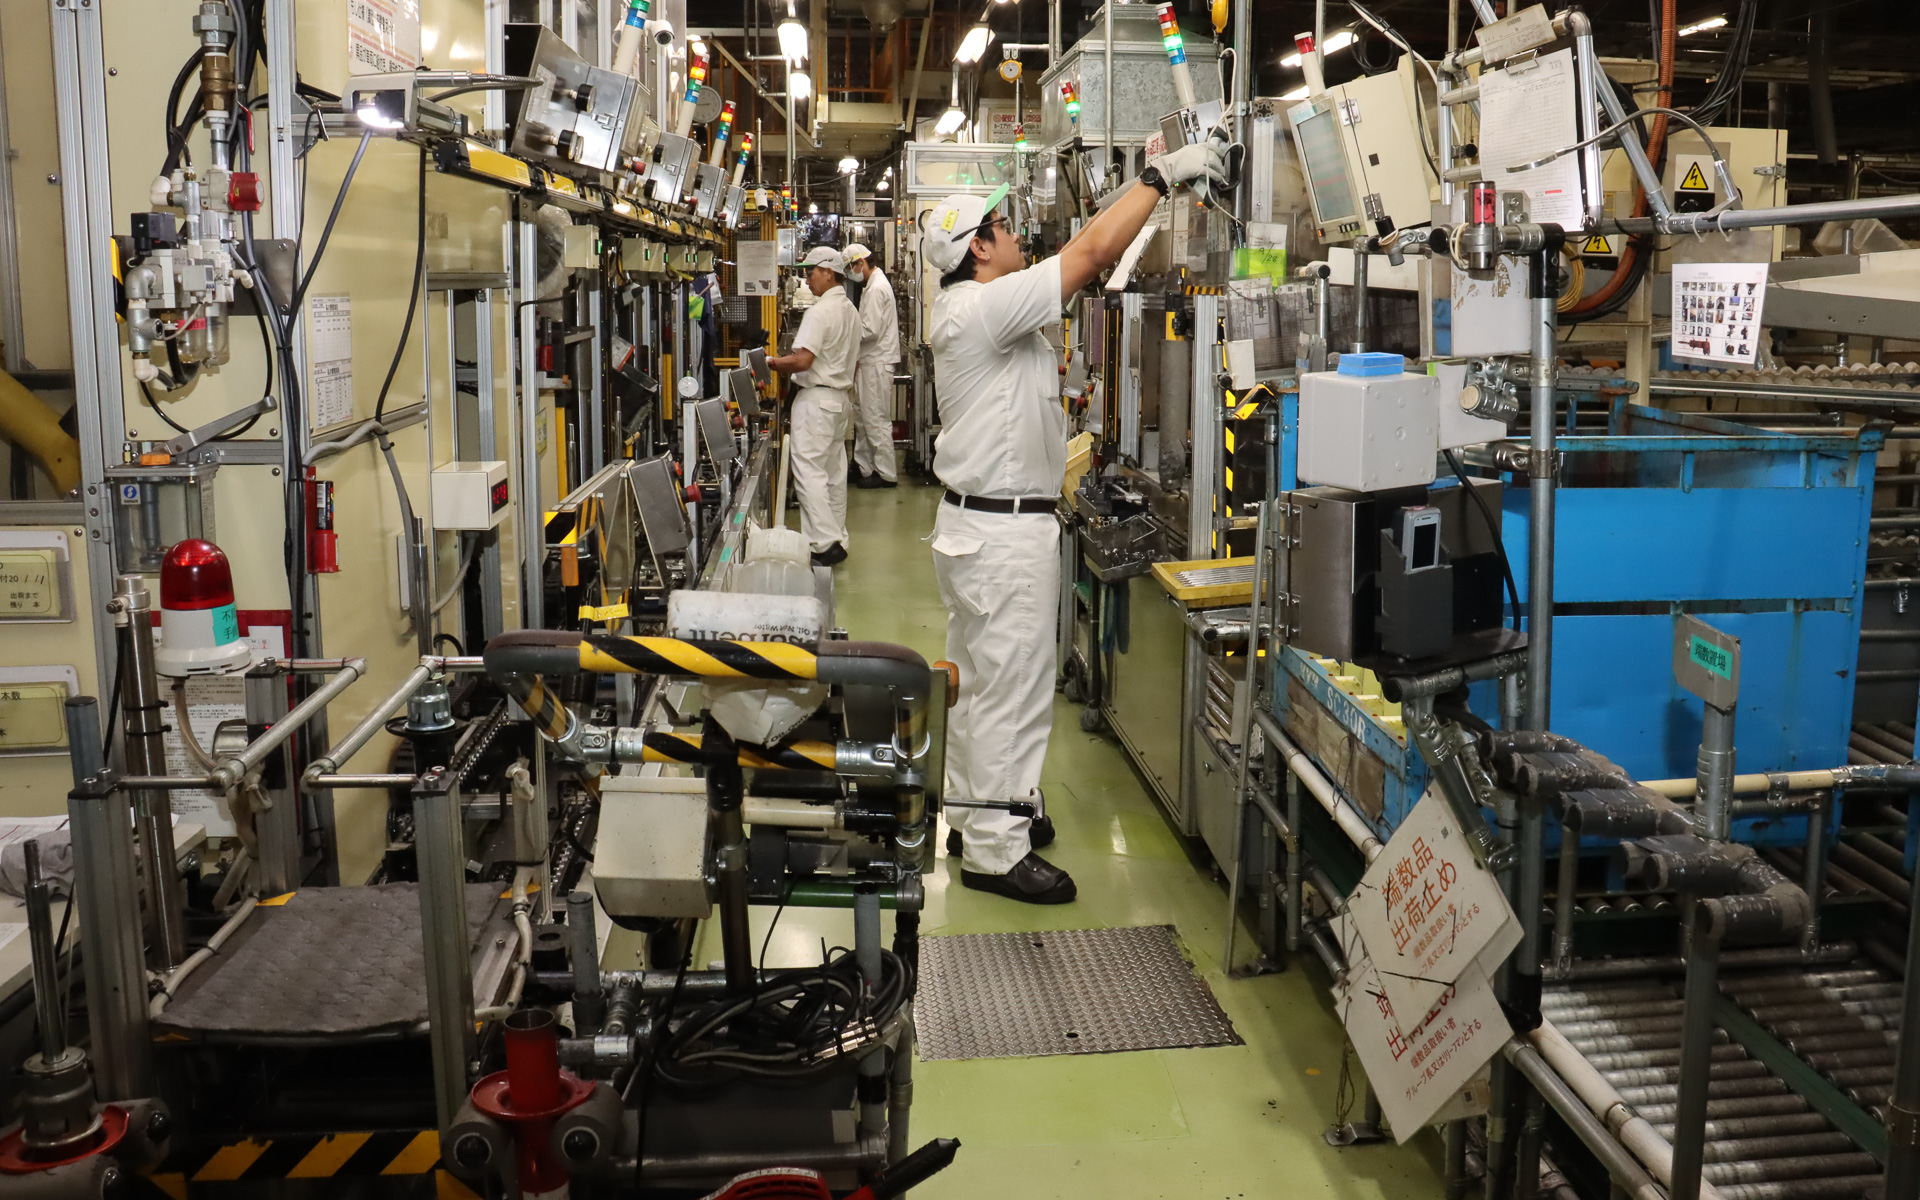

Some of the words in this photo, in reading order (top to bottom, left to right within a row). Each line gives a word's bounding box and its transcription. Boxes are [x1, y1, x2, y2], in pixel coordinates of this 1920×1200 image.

[1259, 243, 1278, 265] 9/28
[10, 601, 23, 609] 残り
[1381, 835, 1435, 912] 端数品
[1390, 858, 1458, 953] 出荷止め
